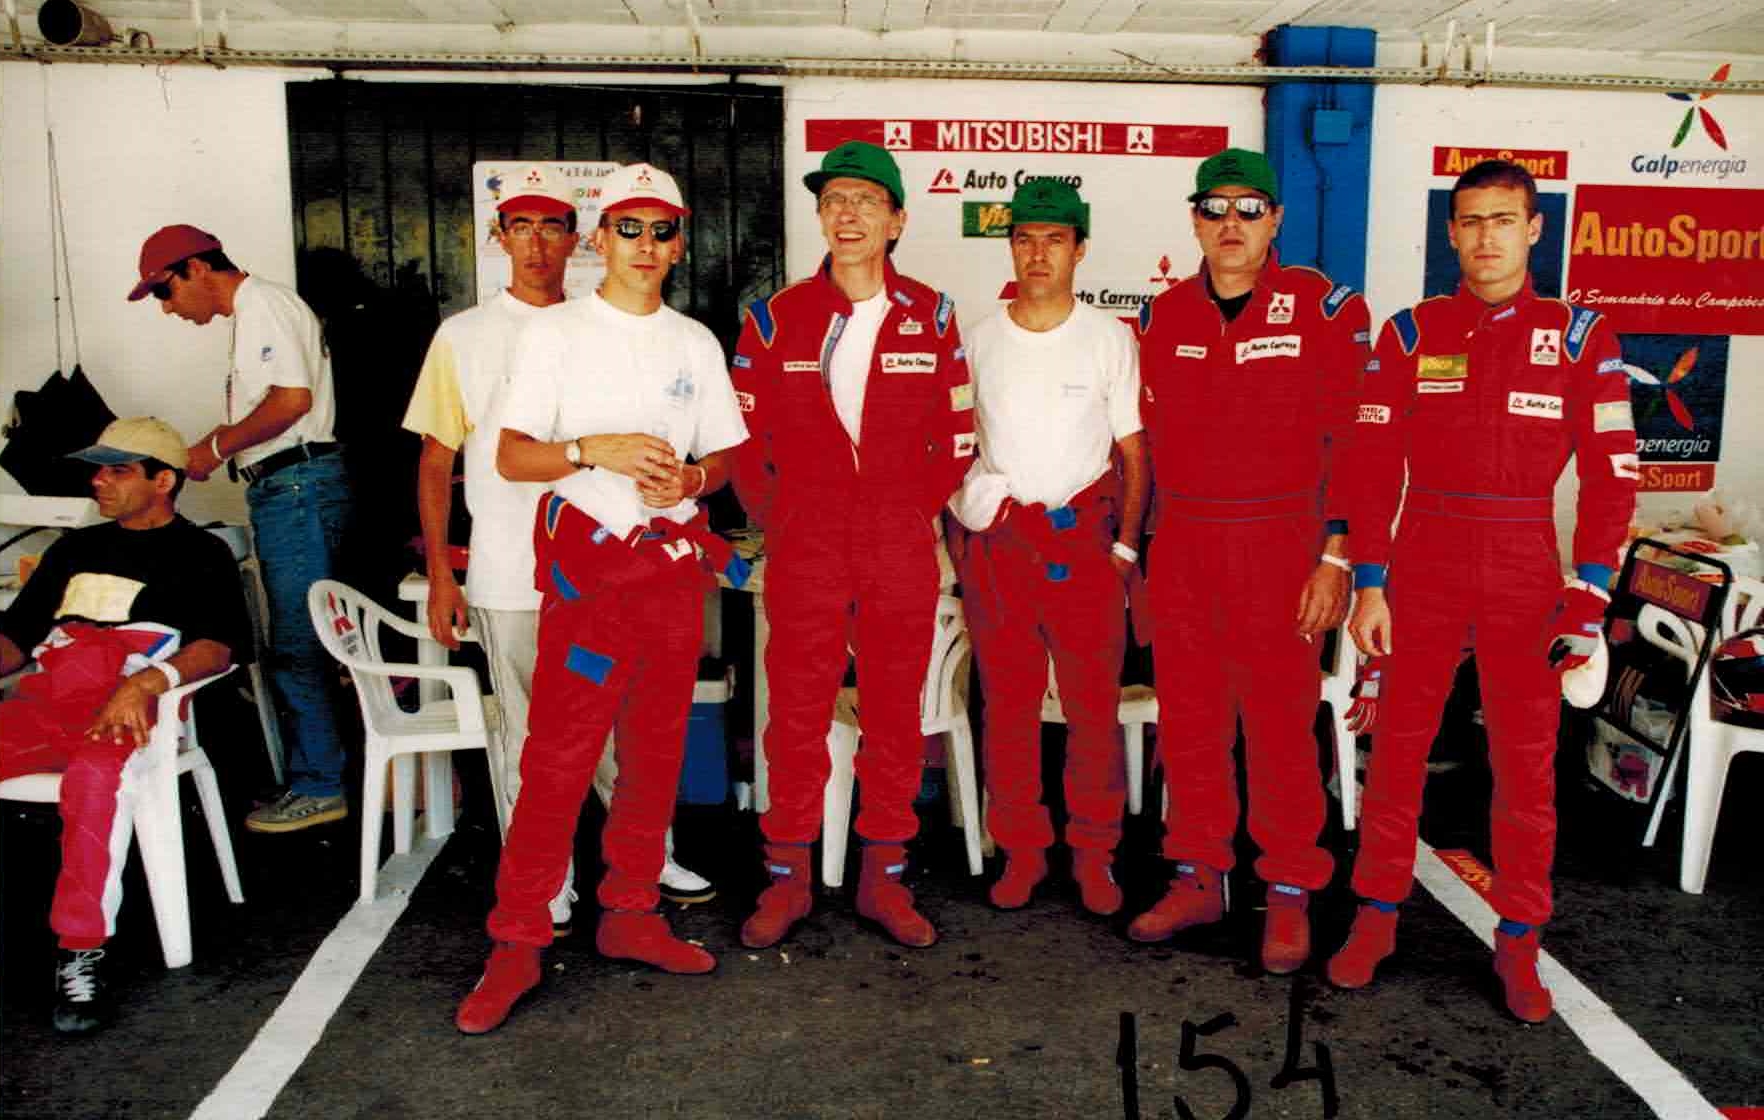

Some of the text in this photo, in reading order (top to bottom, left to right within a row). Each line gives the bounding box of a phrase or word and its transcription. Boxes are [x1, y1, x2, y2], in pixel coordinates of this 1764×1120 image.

[936, 121, 1102, 152] MITSUBISHI
[1444, 148, 1555, 176] Auort
[1631, 154, 1747, 179] Galpenergia
[964, 170, 1007, 189] Auto
[1115, 978, 1341, 1120] 154
